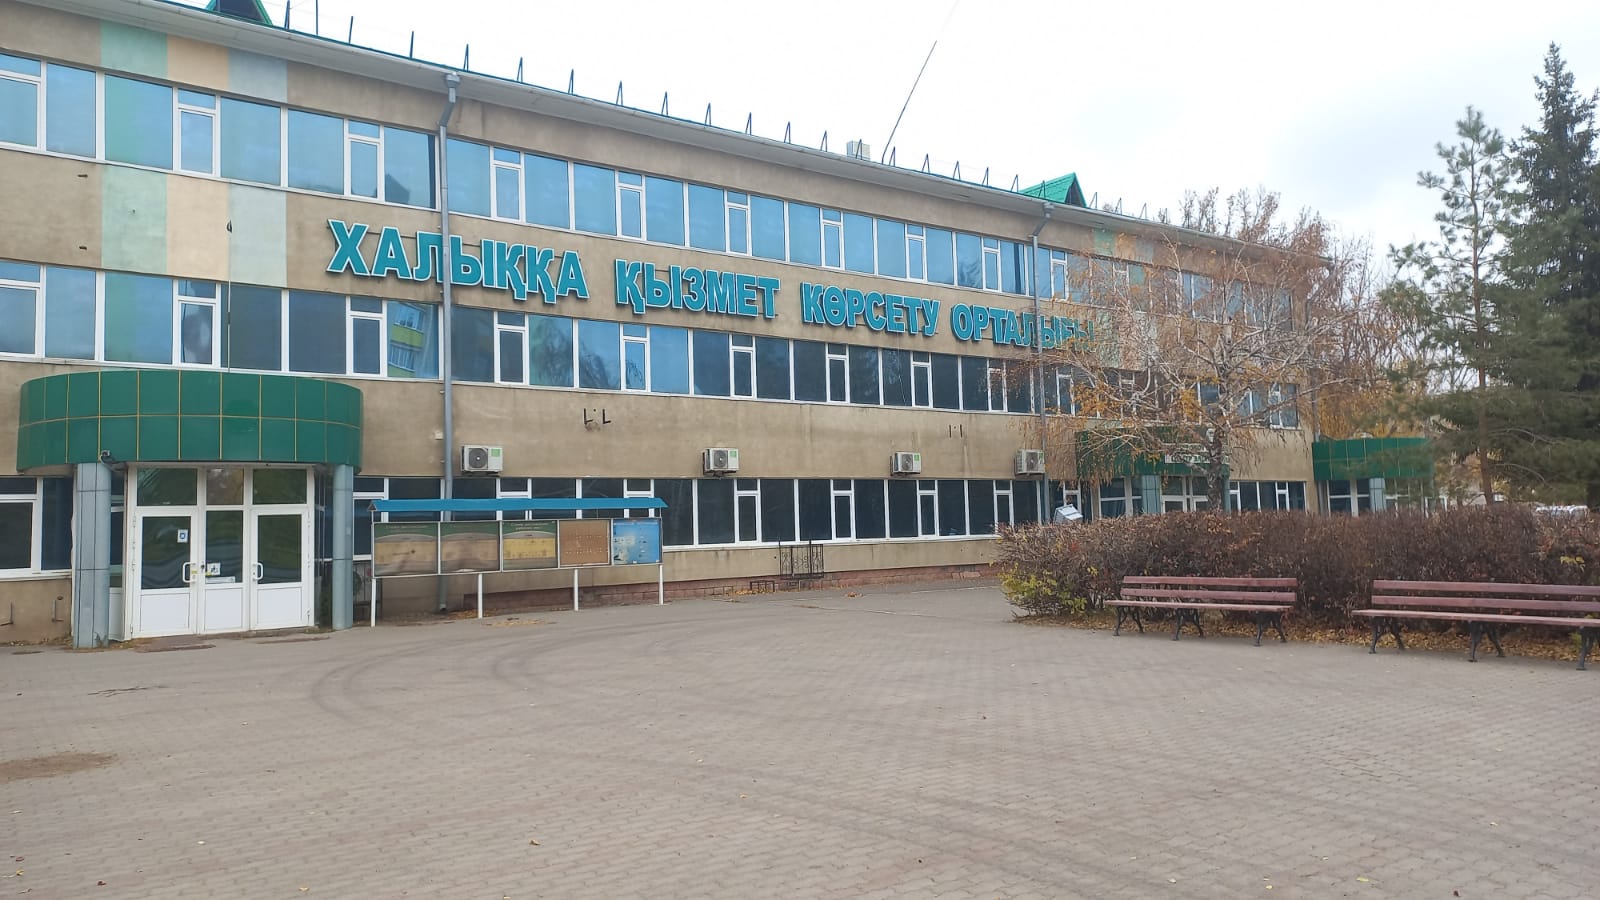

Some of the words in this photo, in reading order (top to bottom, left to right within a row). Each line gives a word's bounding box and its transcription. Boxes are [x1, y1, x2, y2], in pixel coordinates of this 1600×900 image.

[326, 219, 590, 304] ХАЛЫҚҚА
[615, 258, 781, 319] ҚЫЗМЕТ
[800, 282, 941, 337] КӨРСЕТУ
